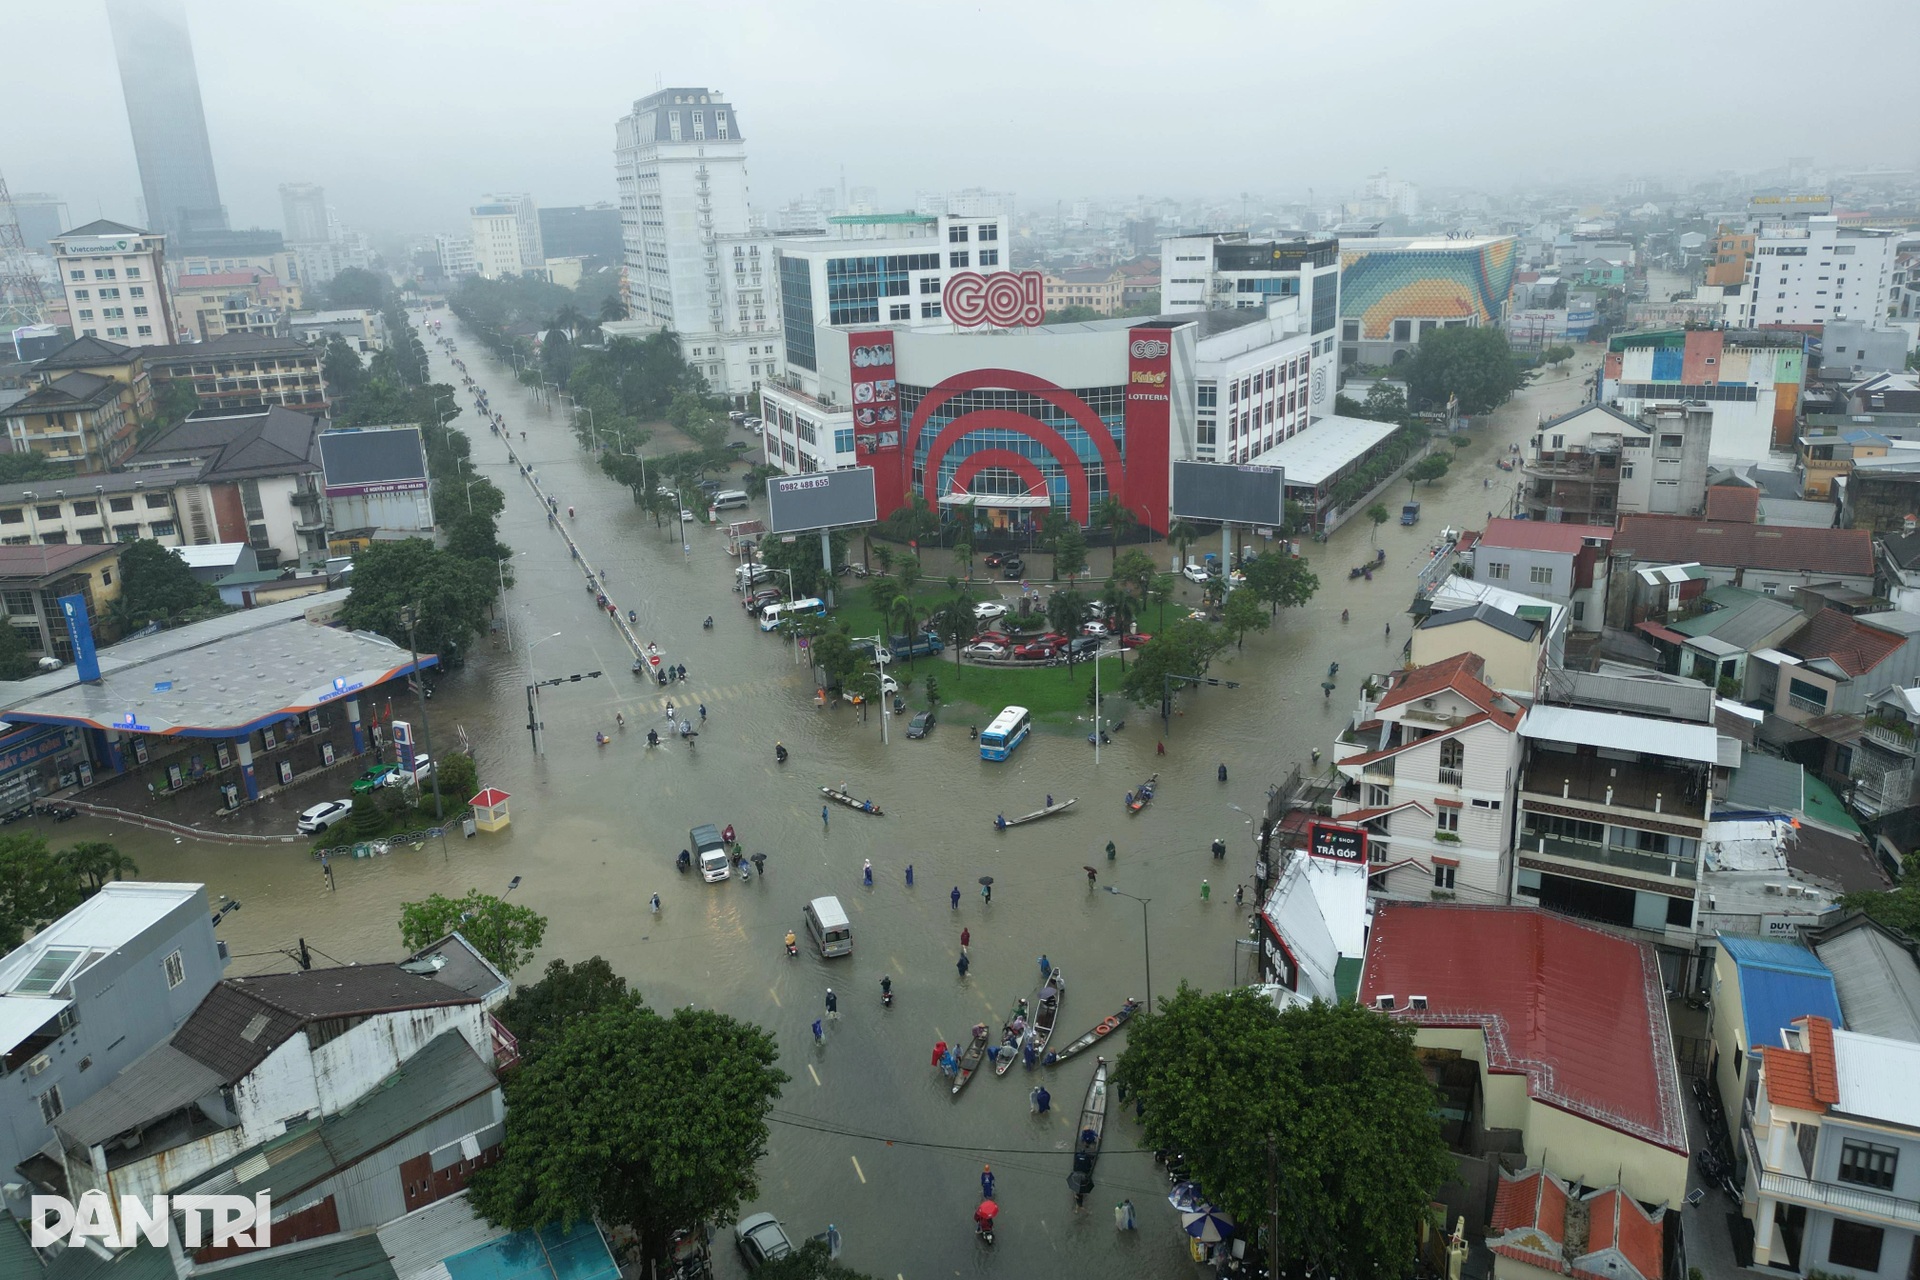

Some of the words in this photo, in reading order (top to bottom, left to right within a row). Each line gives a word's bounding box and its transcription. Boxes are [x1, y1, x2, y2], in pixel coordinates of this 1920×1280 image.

[70, 244, 117, 253] Vietcombank
[943, 271, 1045, 328] GO!
[1128, 393, 1169, 401] LOTTERIA
[780, 482, 798, 491] 0982
[815, 478, 829, 487] 655
[70, 617, 82, 660] PETROLIMEX
[318, 682, 364, 702] PETROLIMEX
[112, 722, 151, 731] PETROLIMEX
[1316, 845, 1336, 856] TRẢ
[1336, 848, 1357, 859] GÓP
[1769, 922, 1791, 930] DUY
